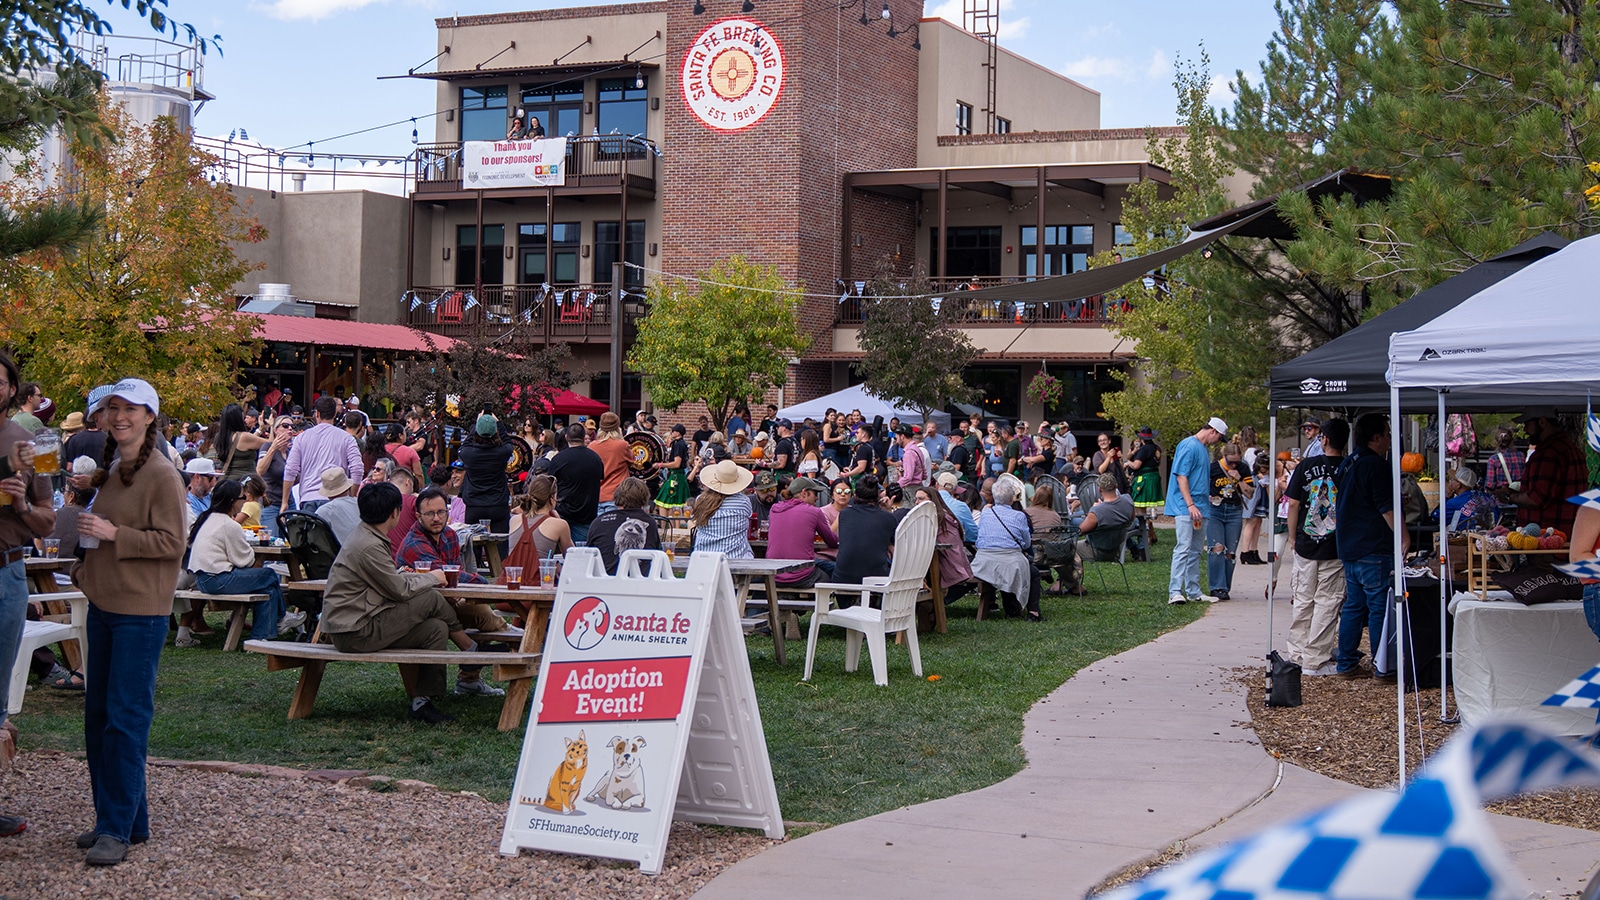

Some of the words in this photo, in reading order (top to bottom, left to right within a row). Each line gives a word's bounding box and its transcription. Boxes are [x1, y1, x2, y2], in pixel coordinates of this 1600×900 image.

[689, 51, 706, 101] SANTA
[702, 32, 720, 52] FE
[723, 26, 778, 69] BREWING
[758, 75, 776, 97] CO.
[707, 107, 727, 122] EST.
[732, 105, 756, 121] 1988
[493, 142, 517, 152] Thank
[518, 142, 532, 151] you
[481, 156, 489, 165] to
[490, 156, 504, 165] our
[504, 153, 543, 165] sponsors!
[613, 612, 667, 633] santa
[670, 612, 691, 634] fe
[611, 633, 646, 643] ANIMAL
[648, 635, 688, 645] SHELTER
[562, 666, 663, 693] Adoption
[575, 692, 645, 715] Event!
[528, 818, 639, 843] SFHumaneSociety.org
